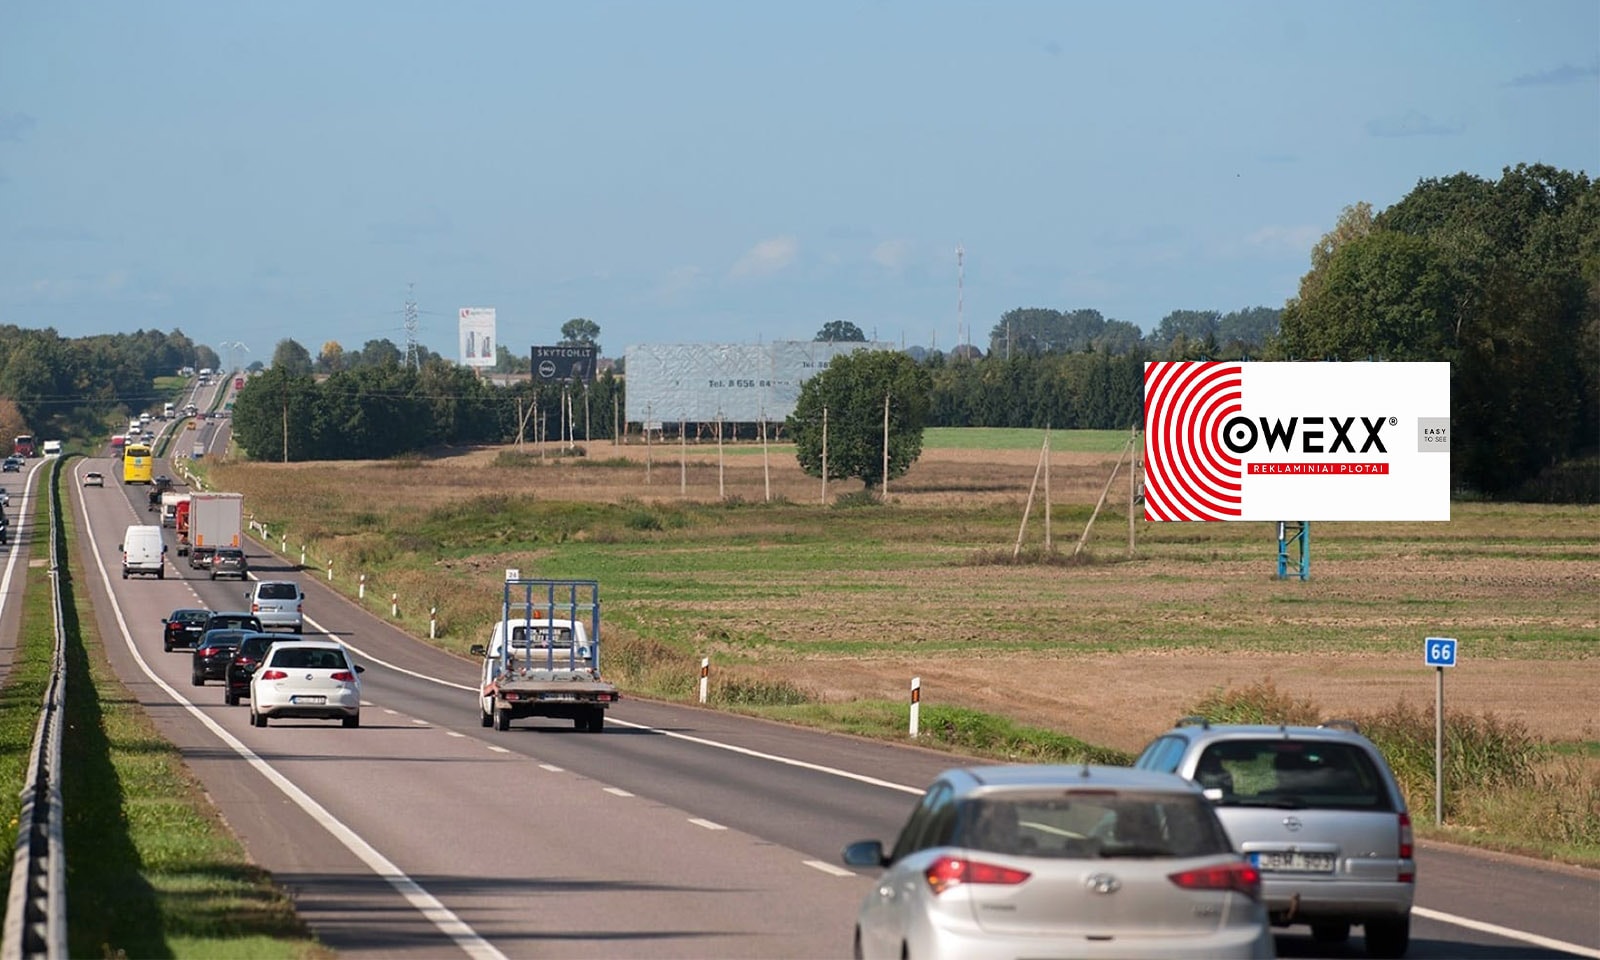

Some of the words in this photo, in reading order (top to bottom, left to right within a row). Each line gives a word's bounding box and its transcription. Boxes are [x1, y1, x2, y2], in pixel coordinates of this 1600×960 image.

[1253, 464, 1334, 474] REKLAMINIAI
[1341, 464, 1384, 474] PLOTAI
[1431, 643, 1451, 660] 66
